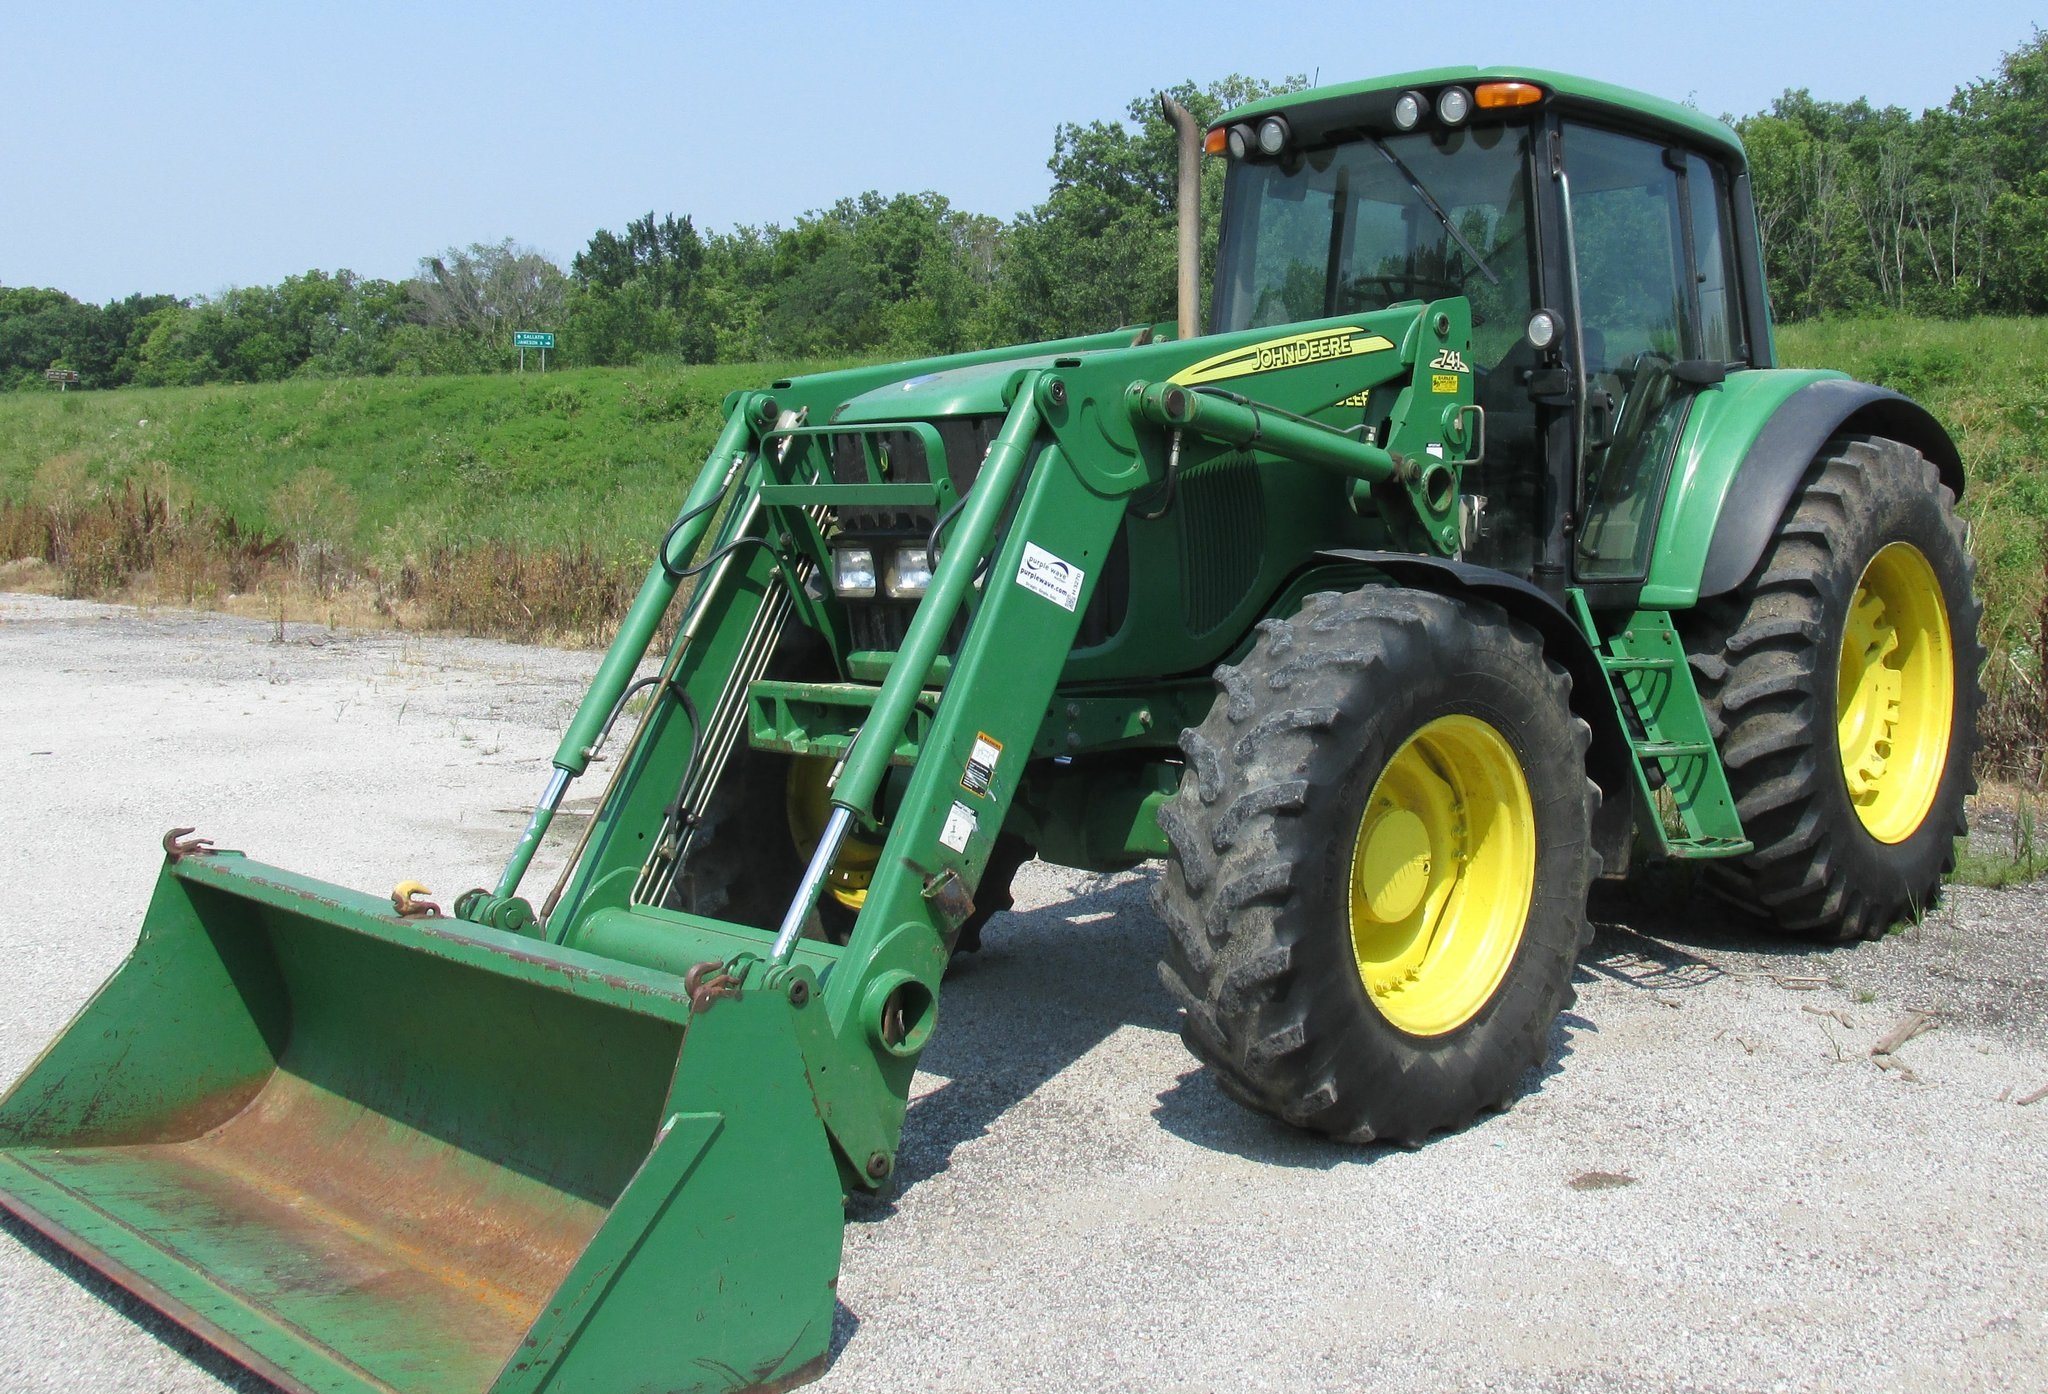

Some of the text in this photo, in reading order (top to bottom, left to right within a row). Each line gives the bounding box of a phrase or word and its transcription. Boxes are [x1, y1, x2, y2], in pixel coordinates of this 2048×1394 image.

[1252, 334, 1353, 370] JOHN DEERE
[1439, 348, 1460, 370] 741
[1028, 556, 1050, 570] purple
[1051, 567, 1067, 580] wave
[1020, 567, 1067, 596] purplewave.com
